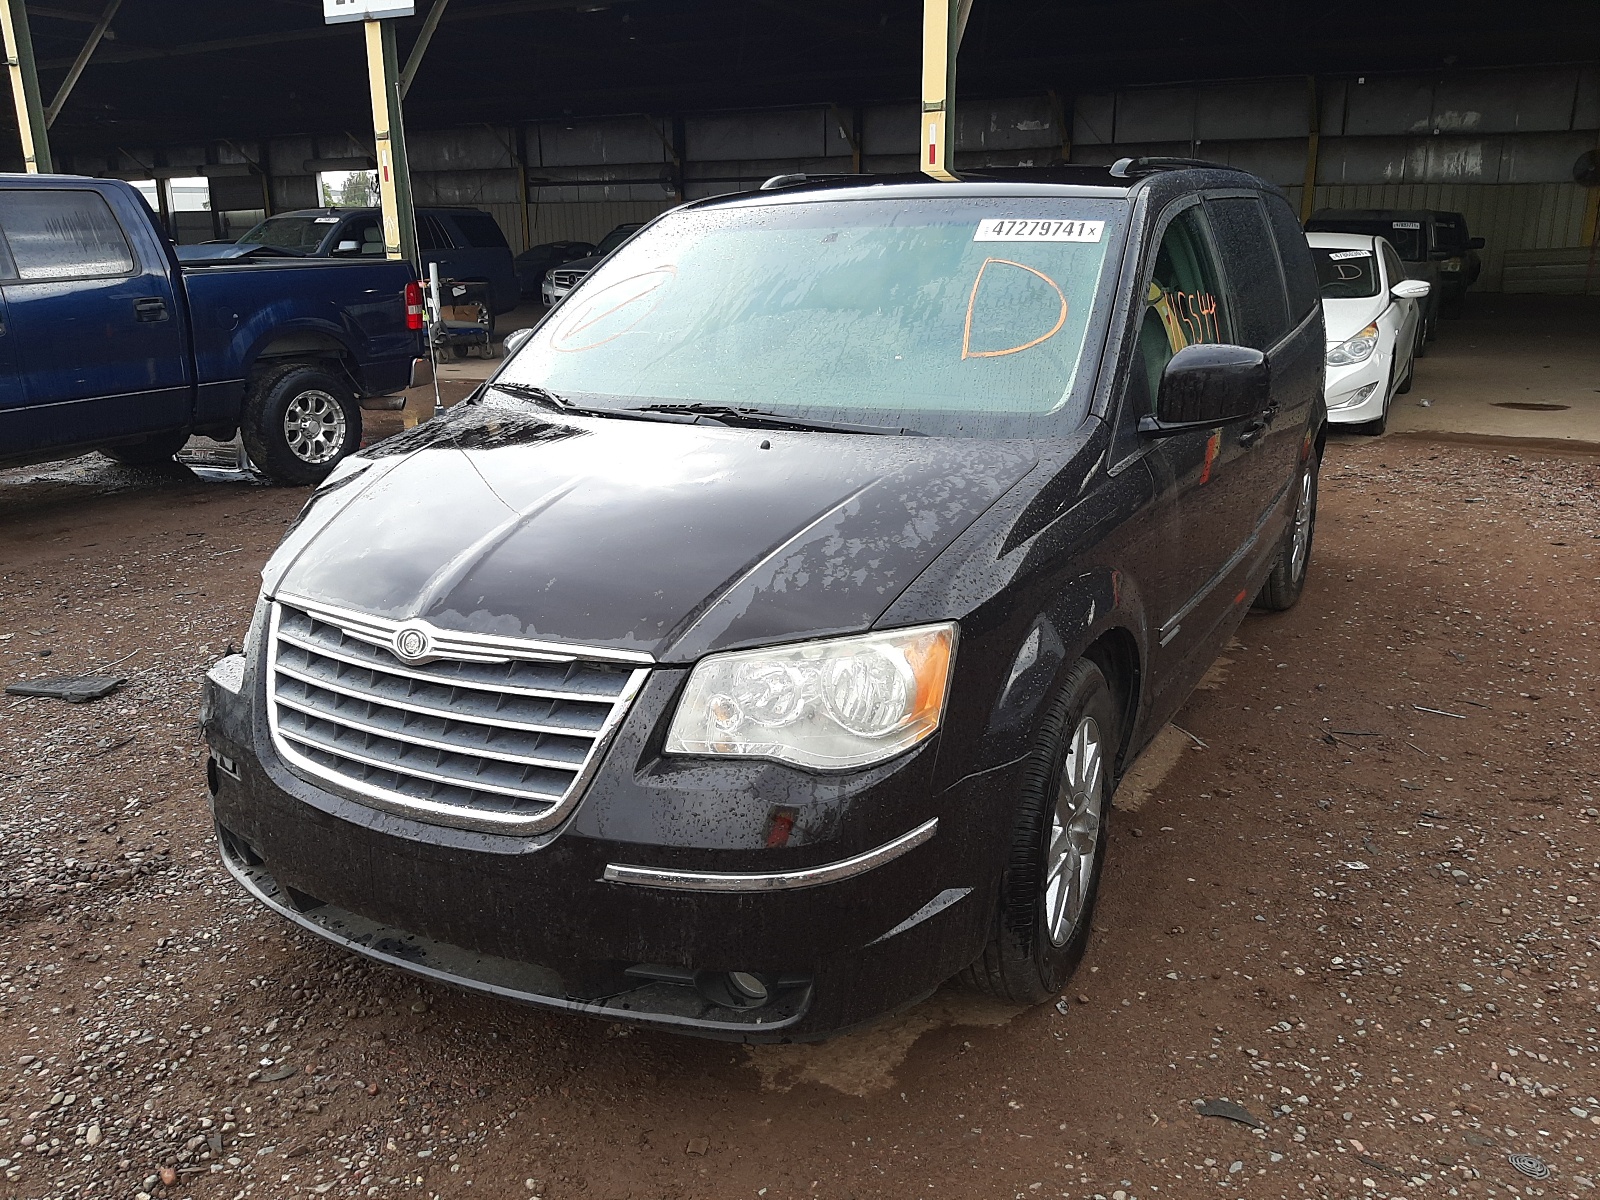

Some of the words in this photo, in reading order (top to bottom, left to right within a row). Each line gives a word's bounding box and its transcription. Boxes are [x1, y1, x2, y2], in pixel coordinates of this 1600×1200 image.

[992, 221, 1086, 237] 47279741
[1332, 264, 1363, 280] D
[961, 257, 1068, 360] D
